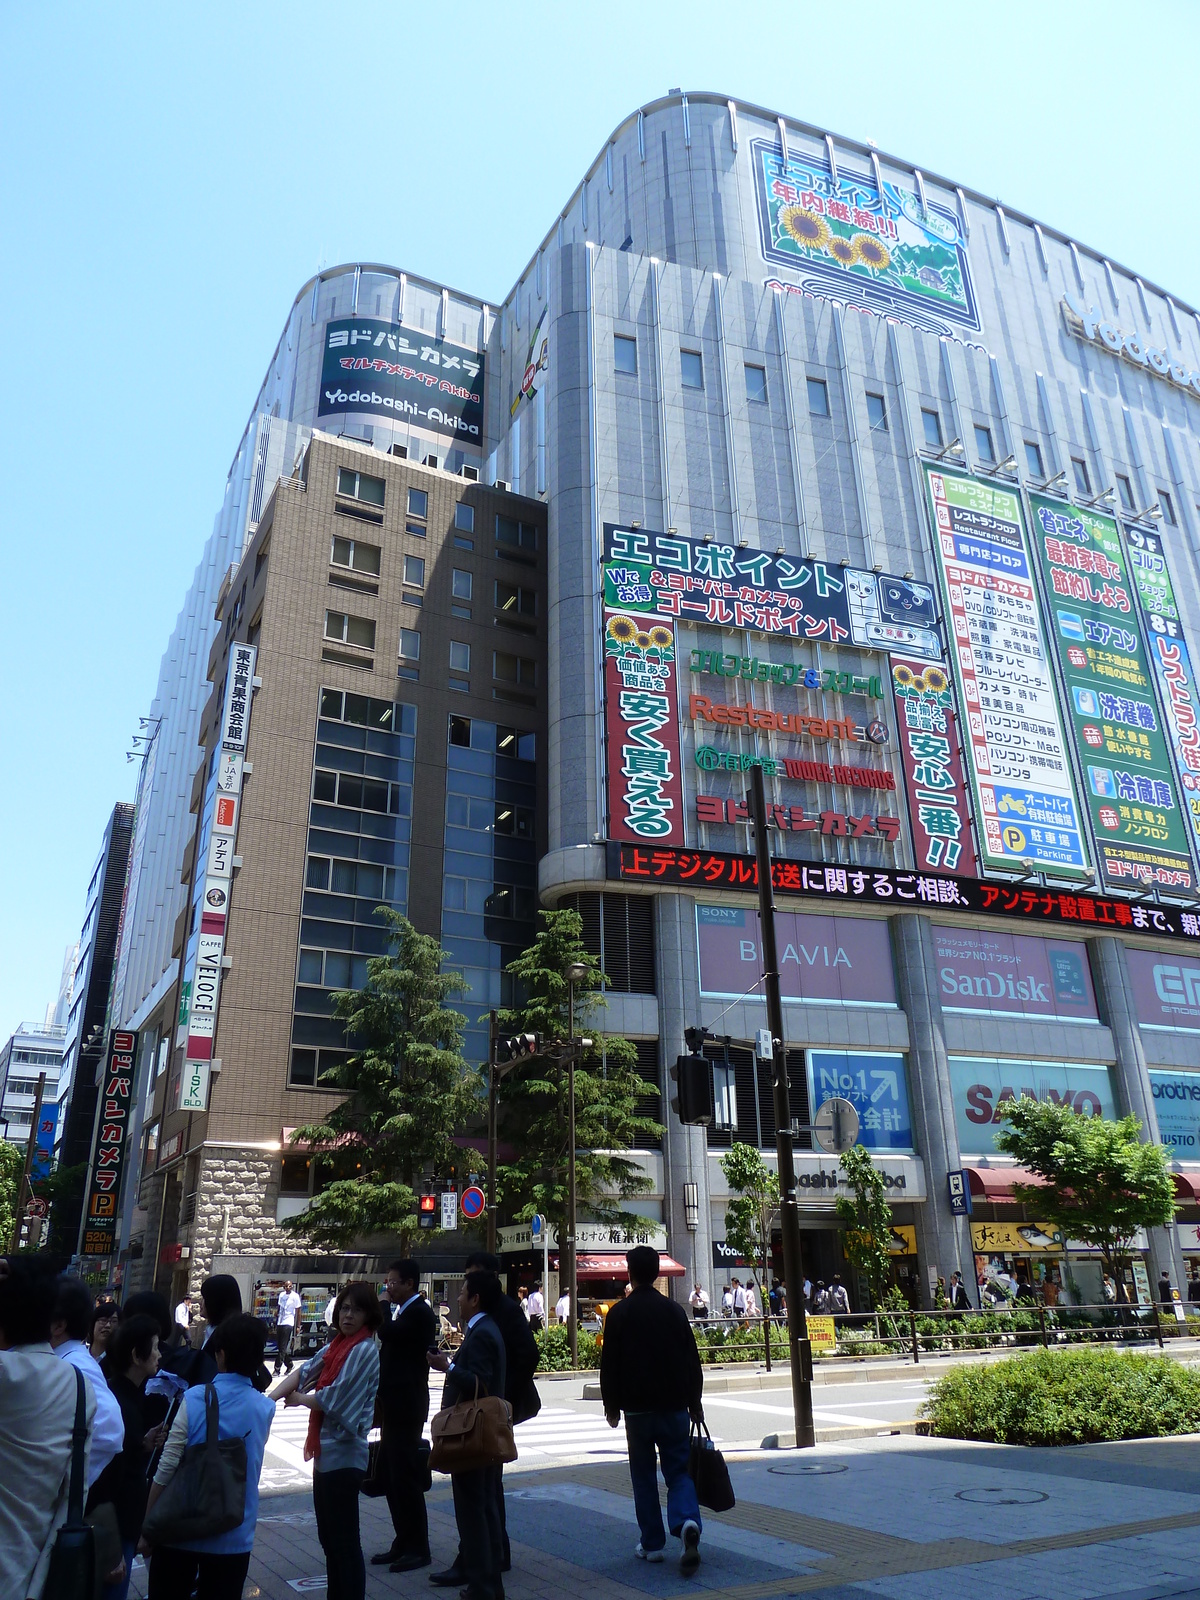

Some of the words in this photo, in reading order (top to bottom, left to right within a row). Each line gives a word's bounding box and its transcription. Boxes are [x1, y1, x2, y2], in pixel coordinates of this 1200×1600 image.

[768, 159, 899, 216] エコポイント
[328, 330, 480, 378] ヨドバシカメラ
[340, 357, 438, 386] マルチメディア
[439, 380, 480, 403] Akiba
[325, 388, 479, 435] Yodobashi-Akiba
[953, 509, 1016, 535] レストランフロア
[953, 523, 1000, 542] Restaurant
[1000, 535, 1020, 547] Floor
[1038, 507, 1090, 543] 省エネ
[943, 539, 953, 550] 7F
[958, 543, 1022, 568] 専門店フロア
[1130, 529, 1157, 552] 9F
[611, 529, 845, 597] エコポイント
[1045, 537, 1122, 582] 最新家電で
[1133, 550, 1164, 574] ゴルフ
[618, 584, 652, 603] お得
[949, 568, 1030, 598] ヨドバシカメラ
[1051, 567, 1131, 613] 節約しよう
[656, 590, 849, 642] ゴールドポイント
[1150, 614, 1178, 637] 8F
[1083, 618, 1138, 653] エアコン
[617, 657, 670, 678] 価値ある
[973, 649, 1026, 669] 各種テレビ
[227, 649, 252, 740] 東京青果商会館
[624, 672, 666, 692] 商品を
[689, 694, 859, 742] Restaurant
[971, 717, 981, 730] 2F
[1099, 691, 1158, 732] 洗濯機
[618, 690, 675, 838] 安く買える
[977, 750, 987, 763] 1F
[783, 758, 833, 784] TOWER
[833, 764, 896, 791] RECORDS
[992, 764, 1031, 780] プリンタ
[908, 731, 963, 869] 安心一番!!
[1025, 793, 1069, 812] オートバイ
[1115, 769, 1176, 810] 冷蔵庫
[218, 798, 226, 825] Adecco
[1031, 828, 1070, 848] 駐車場
[1124, 822, 1169, 841] ノンフロン
[213, 837, 228, 871] アデコ
[1037, 848, 1073, 862] Parking
[1105, 859, 1191, 888] ヨドバシカメラ
[701, 907, 738, 918] SONY
[195, 953, 219, 1011] VELOCE
[940, 967, 1049, 1003] SanDisk
[189, 1064, 203, 1098] TSK
[819, 1067, 866, 1091] No.1
[95, 1032, 135, 1191] ヨドバシカメラ
[183, 1099, 203, 1107] BLD.
